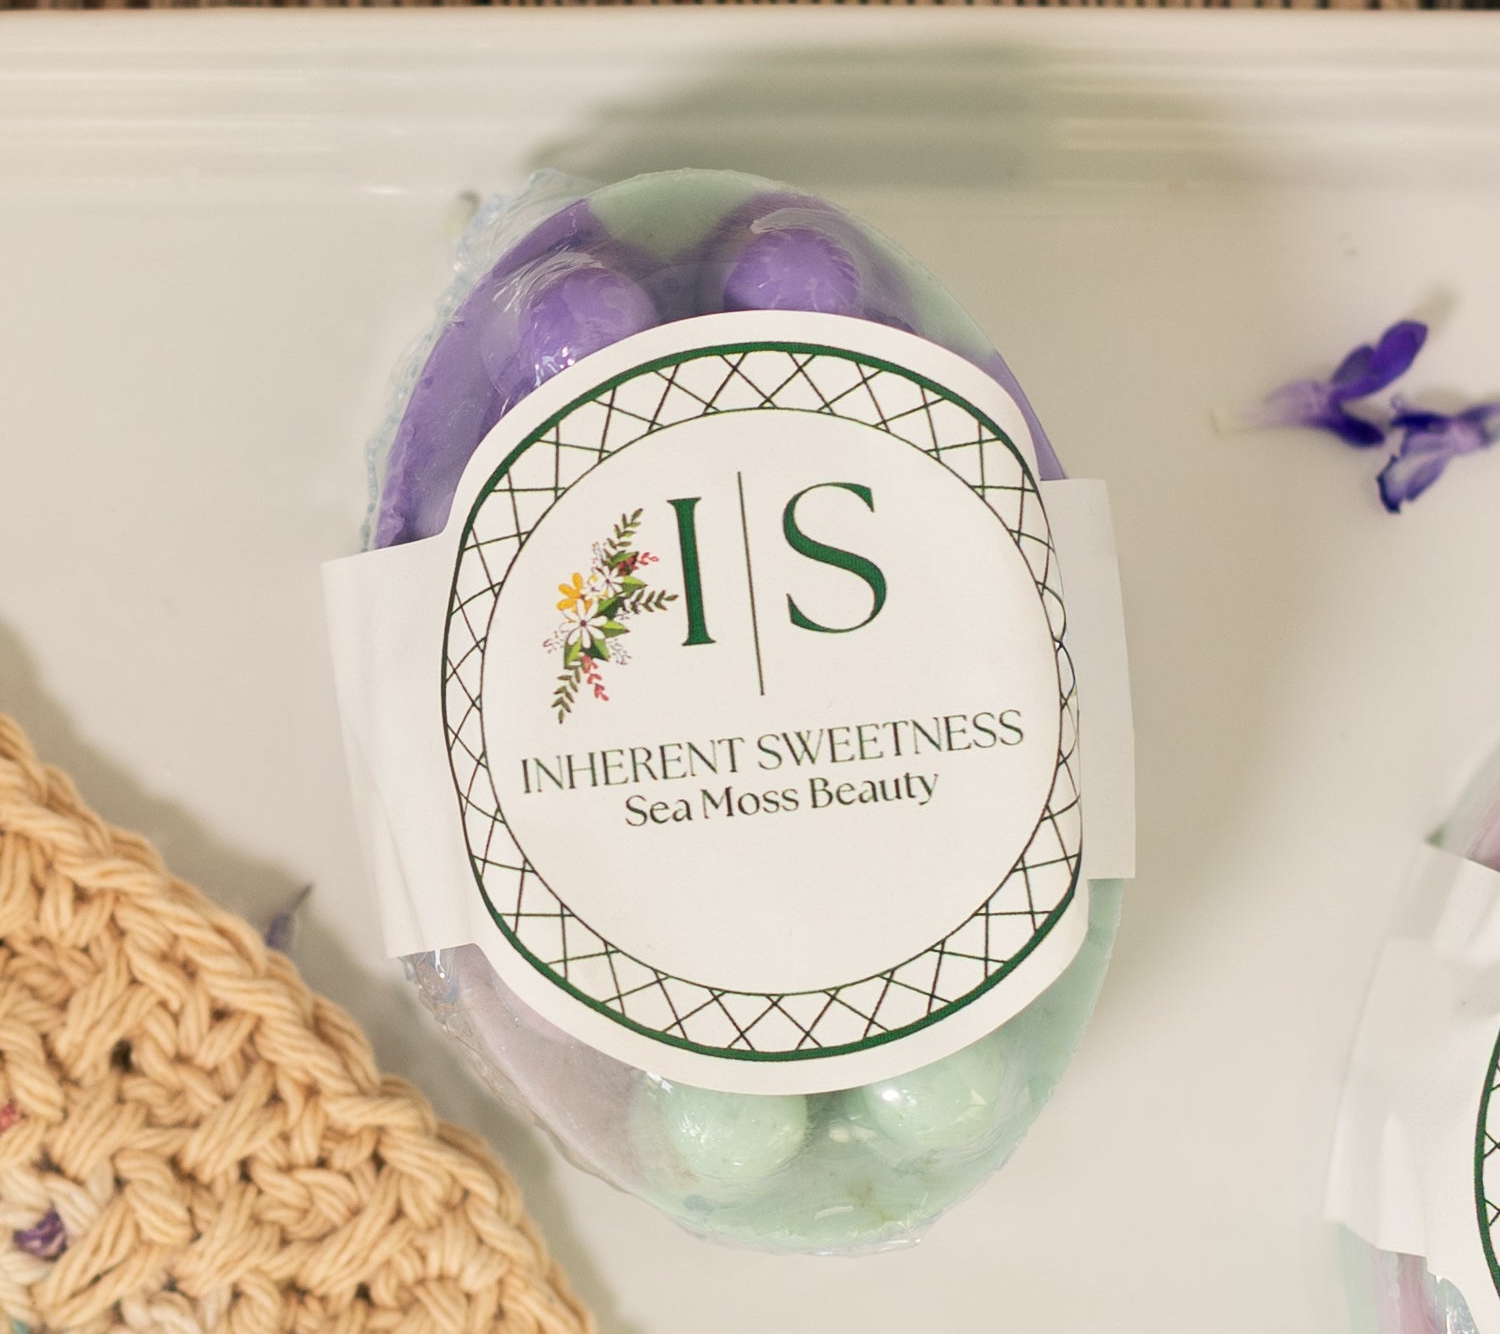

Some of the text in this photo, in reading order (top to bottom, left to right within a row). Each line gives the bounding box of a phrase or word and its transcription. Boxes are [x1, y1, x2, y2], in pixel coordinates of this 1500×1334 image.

[521, 709, 1024, 794] INHERENT SWEETNESS
[625, 772, 939, 827] Sea Moss Beauty
